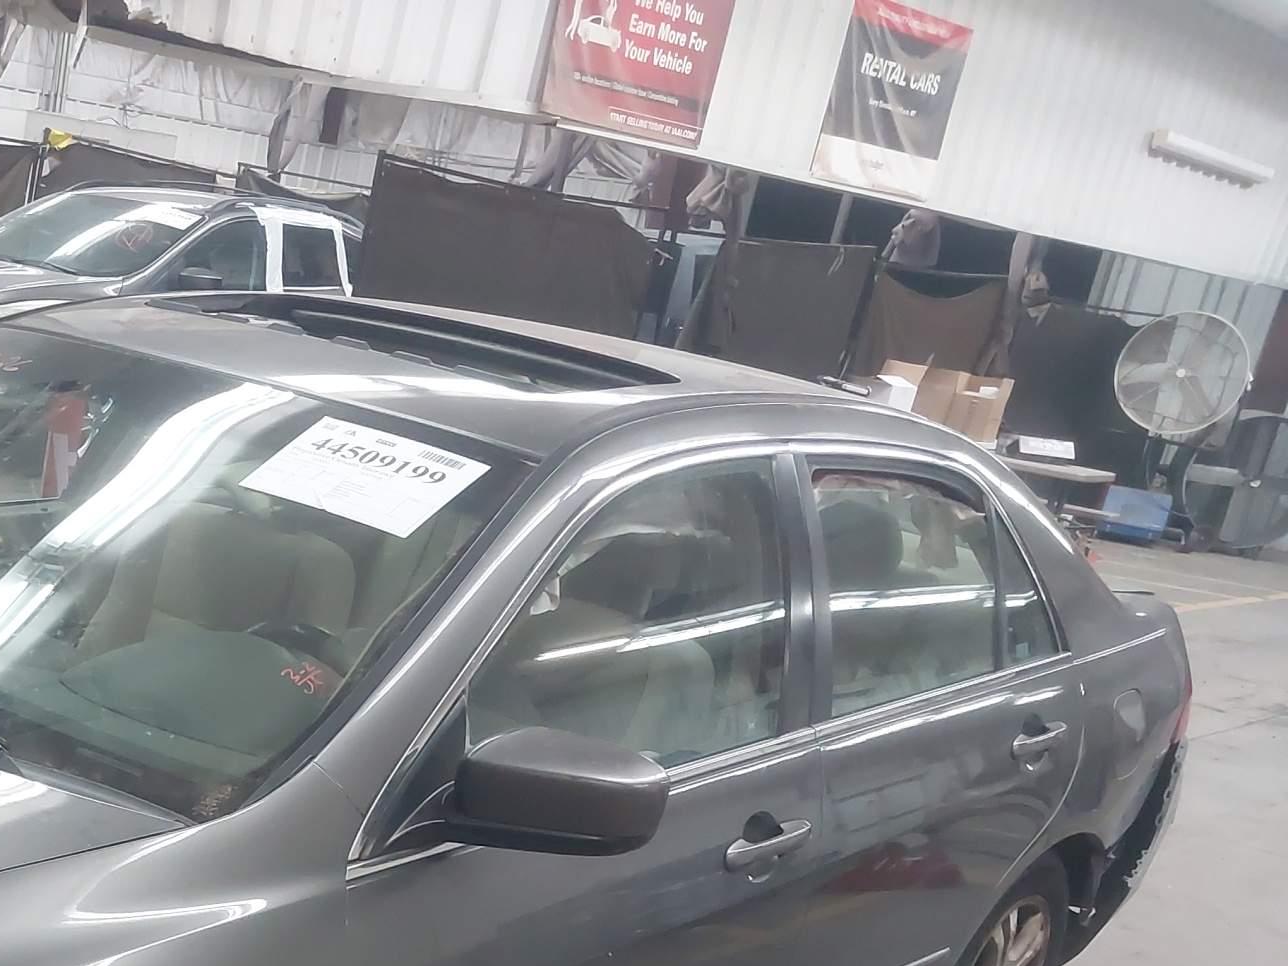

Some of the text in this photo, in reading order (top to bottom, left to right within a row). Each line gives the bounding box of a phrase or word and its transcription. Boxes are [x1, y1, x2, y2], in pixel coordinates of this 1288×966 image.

[628, 13, 709, 53] Earn More For
[656, 0, 681, 22] Help
[684, 3, 704, 26] You
[624, 39, 693, 75] Your Vehicle
[861, 52, 941, 96] RENTAL CARS
[311, 438, 447, 484] 44509199
